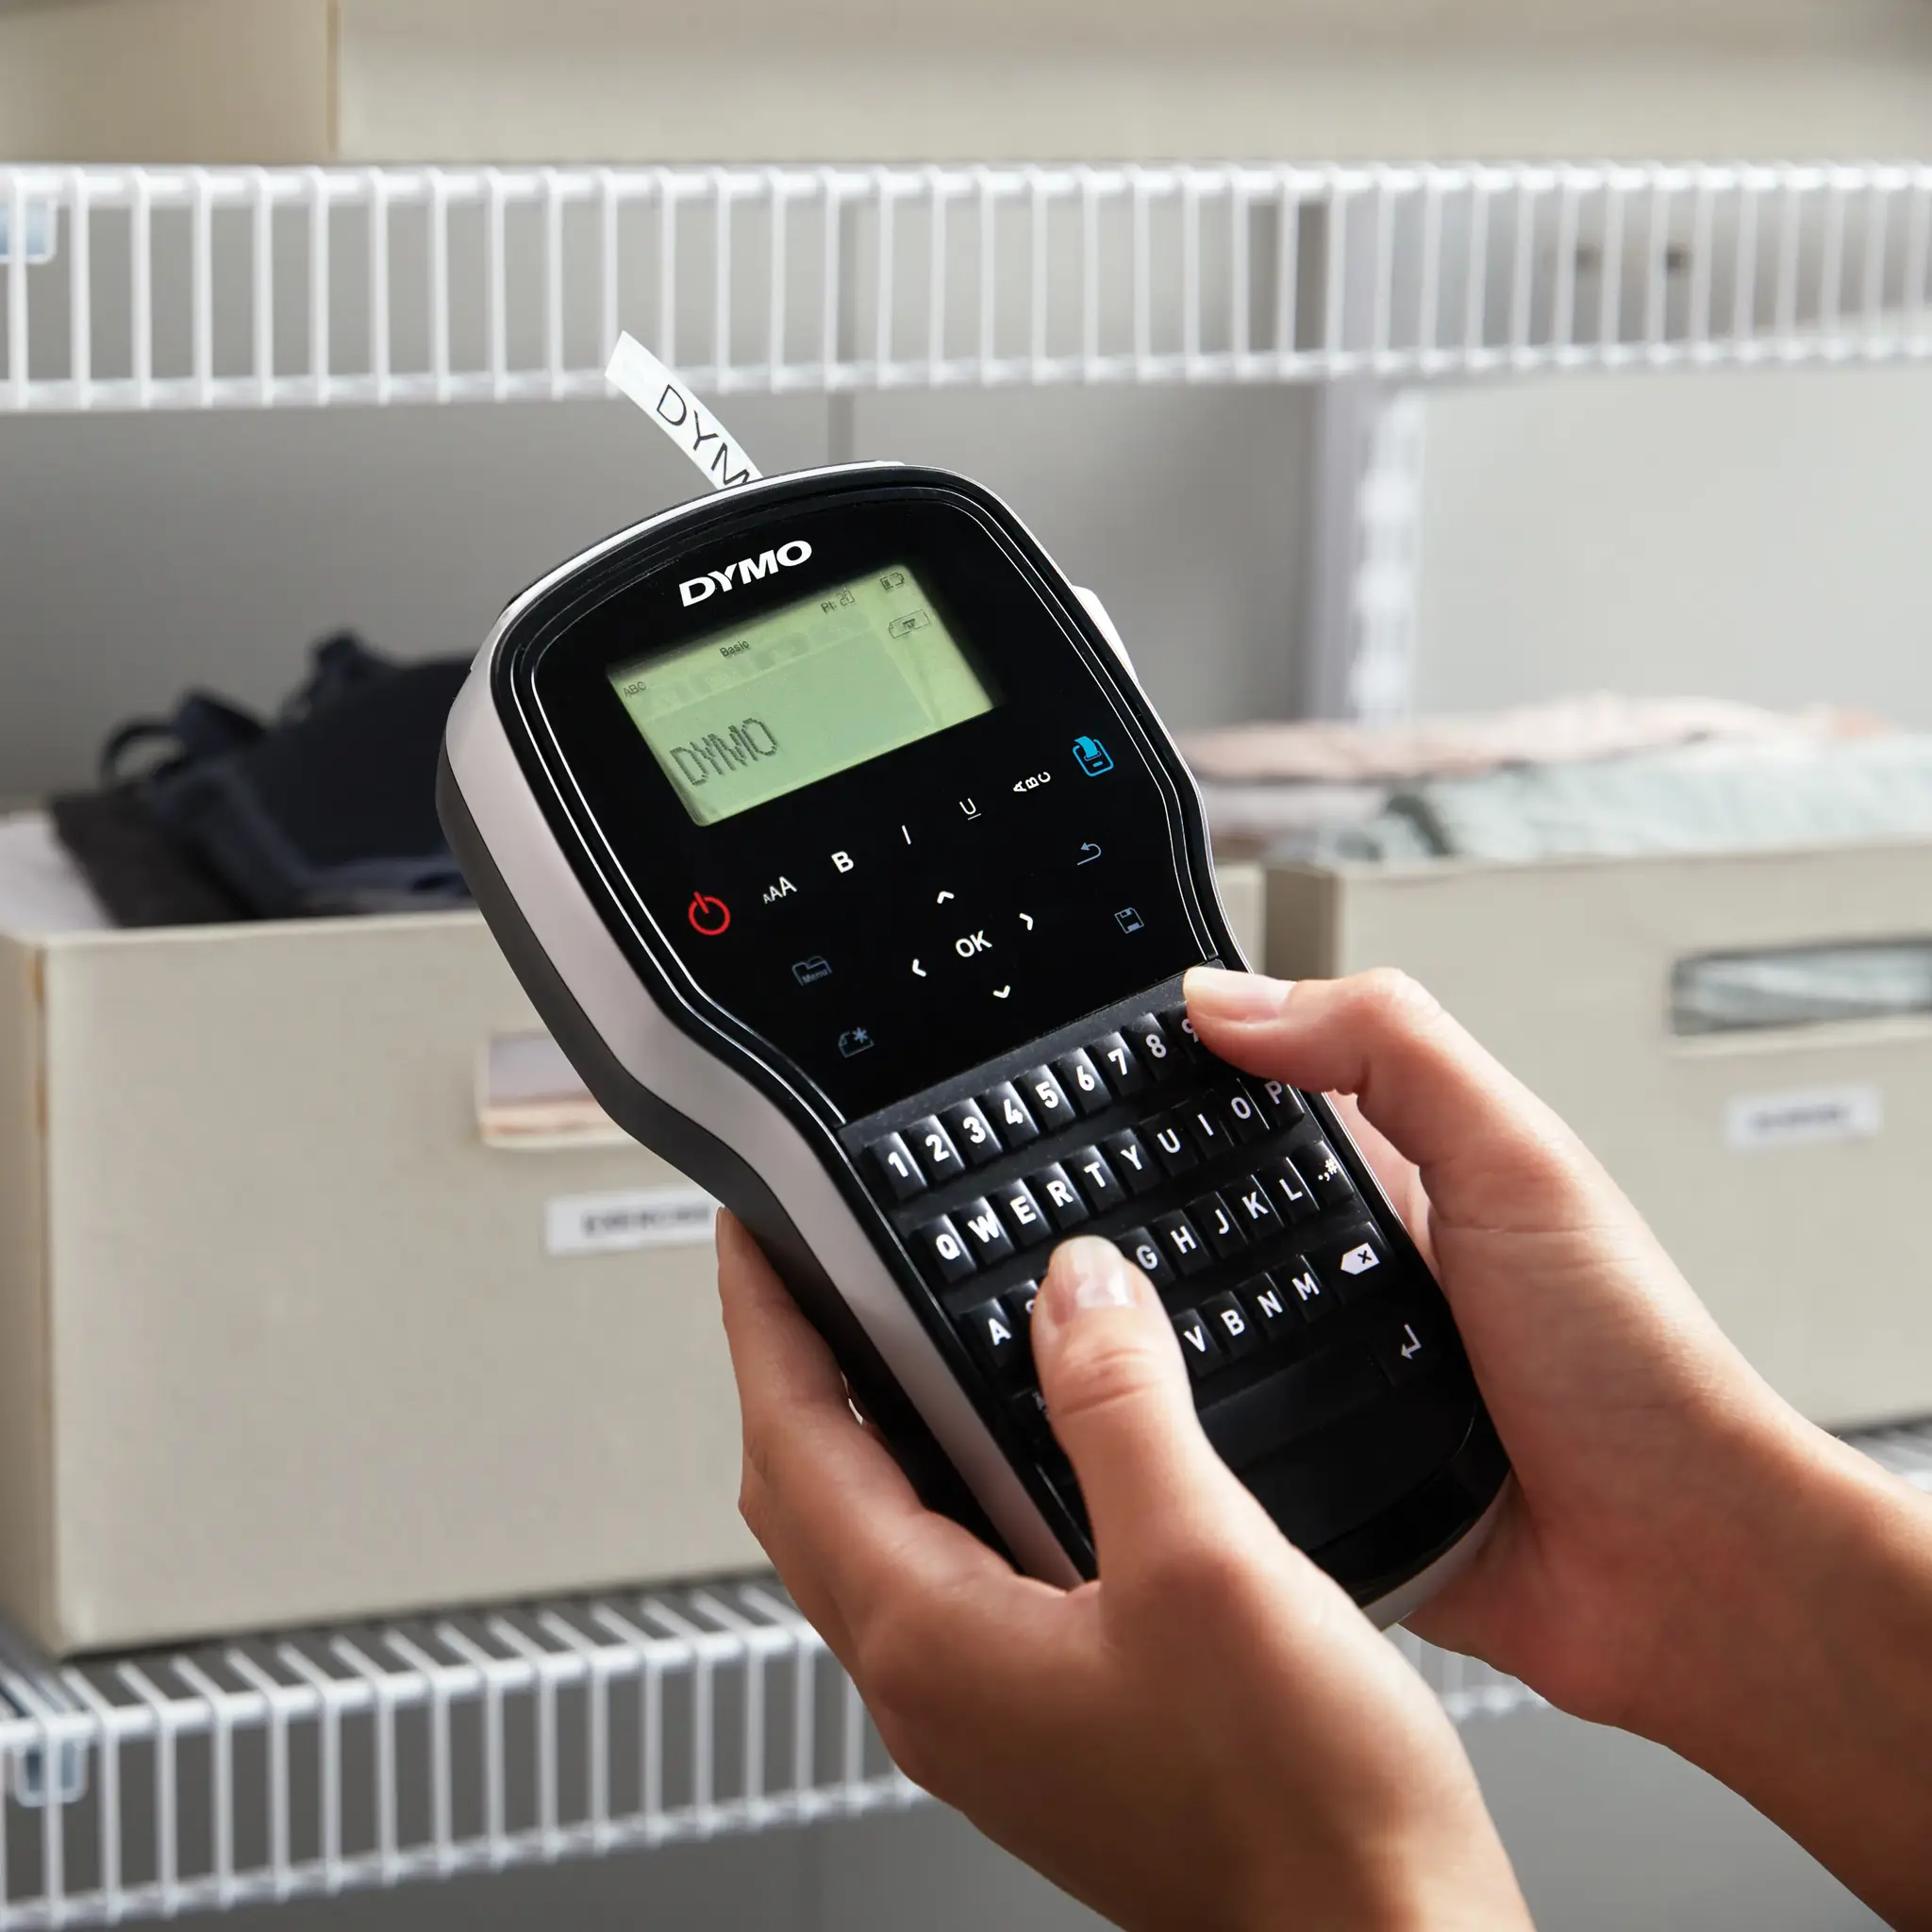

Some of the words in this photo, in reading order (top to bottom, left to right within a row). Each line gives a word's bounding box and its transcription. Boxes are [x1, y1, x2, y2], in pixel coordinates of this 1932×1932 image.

[656, 383, 750, 485] DYM
[678, 540, 812, 608] DYMO
[719, 639, 752, 658] Basic
[622, 680, 647, 698] ABC
[669, 717, 777, 786] DYMO
[1012, 771, 1051, 792] ABC
[831, 851, 855, 874] B
[801, 969, 829, 984] Menu
[955, 930, 993, 958] OK
[888, 1152, 908, 1177] 1
[925, 1134, 950, 1162] 2
[963, 1116, 986, 1143] 3
[1003, 1098, 1024, 1124] 4
[1035, 1081, 1058, 1108] 5
[1075, 1065, 1095, 1091] 6
[1108, 1048, 1127, 1075] 7
[1145, 1034, 1167, 1058] 8
[936, 1233, 960, 1260] Q
[967, 1210, 1000, 1243] W
[1009, 1195, 1037, 1224] E
[1046, 1179, 1074, 1208] R
[1083, 1161, 1107, 1188] T
[1120, 1144, 1142, 1171] Y
[1157, 1129, 1180, 1154] U
[1198, 1114, 1214, 1137] I
[1231, 1097, 1251, 1120] O
[1265, 1080, 1283, 1105] P
[988, 1318, 1011, 1346] A
[1136, 1244, 1158, 1270] G
[1170, 1225, 1197, 1255] H
[1215, 1208, 1229, 1235] J
[1241, 1191, 1269, 1220] K
[1279, 1178, 1303, 1201] L
[1183, 1324, 1206, 1353] V
[1221, 1308, 1245, 1337] B
[1257, 1291, 1283, 1318] N
[1291, 1272, 1320, 1301] M
